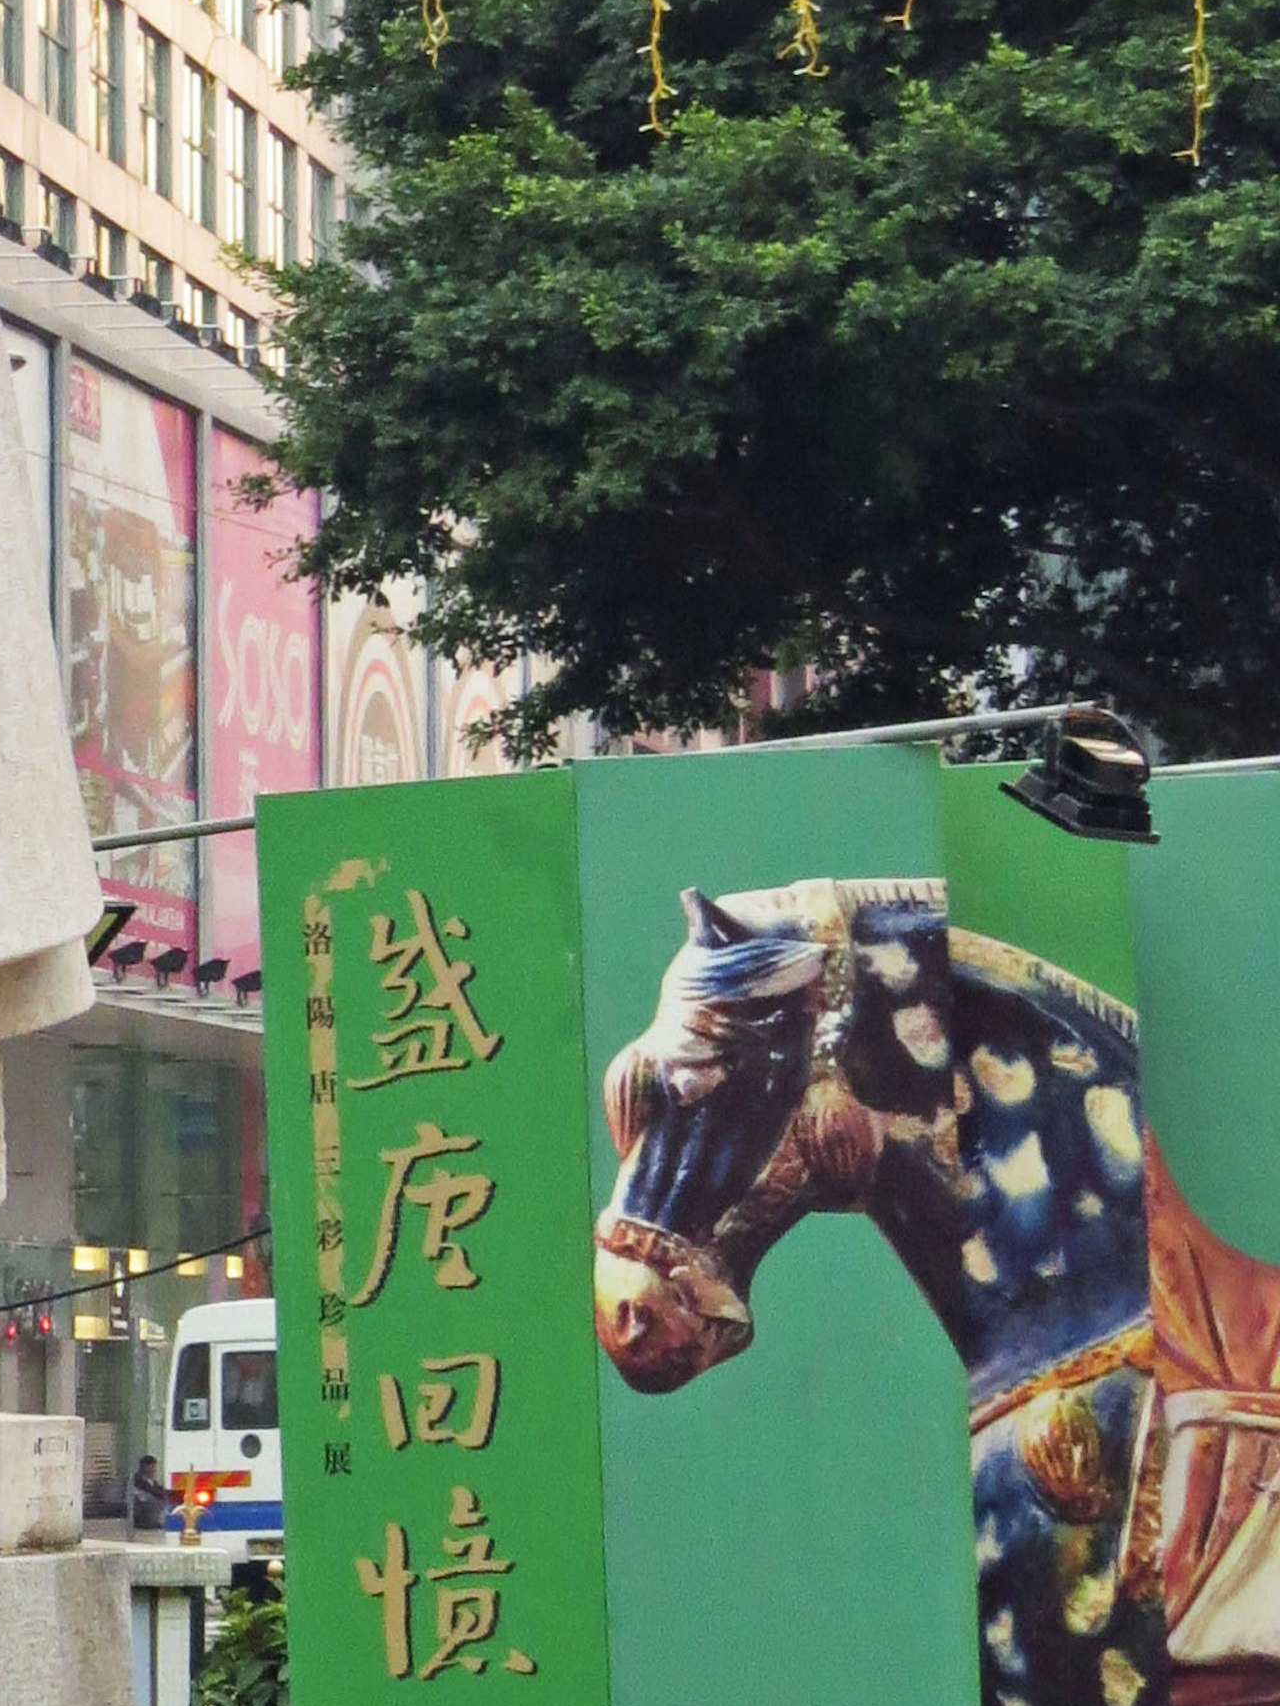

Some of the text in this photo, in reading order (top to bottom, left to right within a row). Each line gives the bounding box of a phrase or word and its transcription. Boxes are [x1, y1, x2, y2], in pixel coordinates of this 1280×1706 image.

[302, 920, 354, 1476] 洛陽唐三彩珍品展
